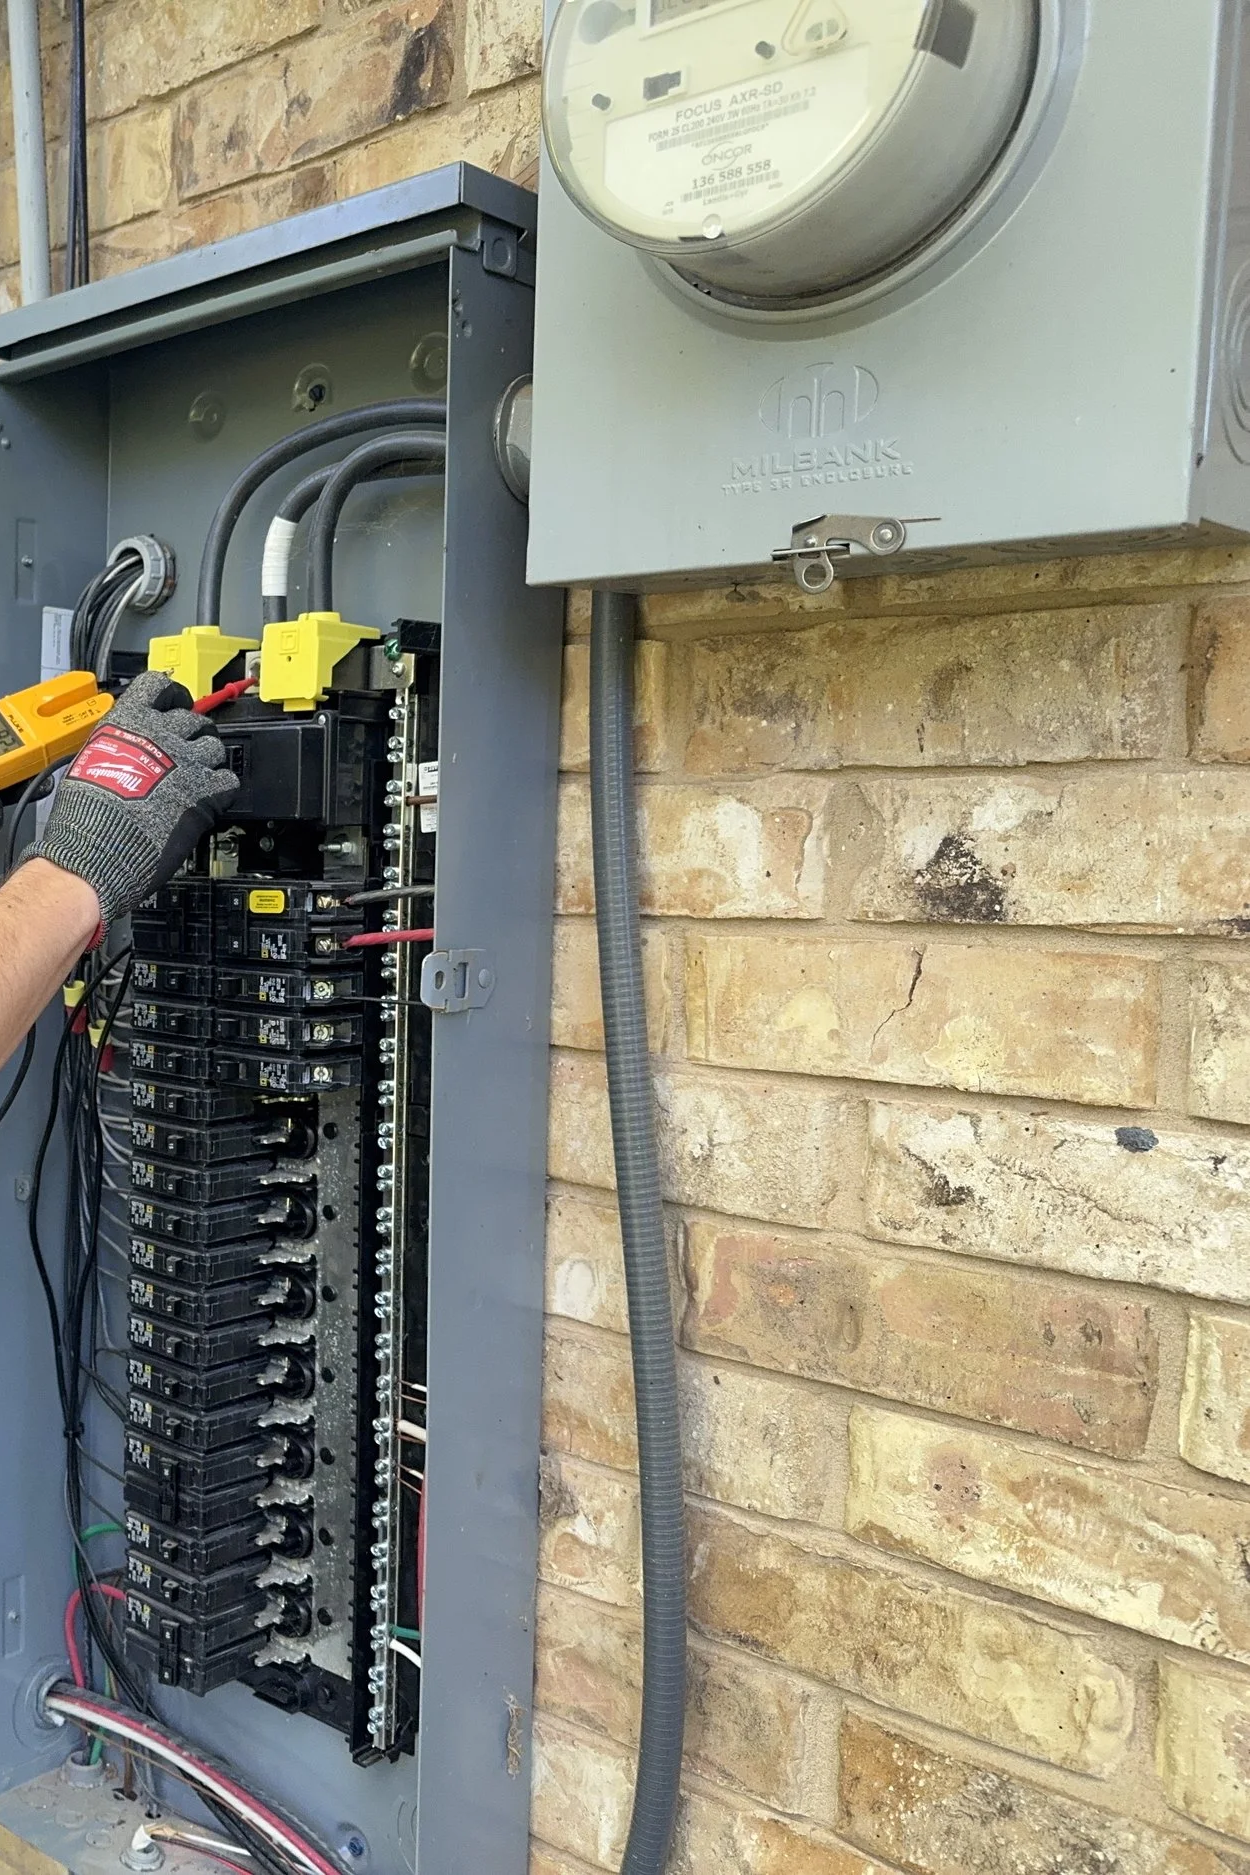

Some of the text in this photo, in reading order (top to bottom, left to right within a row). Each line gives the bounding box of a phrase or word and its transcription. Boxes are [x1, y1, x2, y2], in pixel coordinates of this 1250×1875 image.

[675, 81, 783, 123] FOCUS AXR-SD
[648, 128, 669, 142] FORM
[682, 119, 704, 133] CL200
[706, 113, 725, 128] 240V
[701, 144, 752, 166] ONCOR
[692, 160, 771, 190] 136 588 558
[731, 439, 900, 480] MILBANK
[721, 480, 762, 496] TYPE
[800, 462, 913, 488] ENCLOSURE
[8, 714, 24, 734] FLUKE
[145, 745, 162, 758] CUT
[86, 767, 142, 791] Milwaukee
